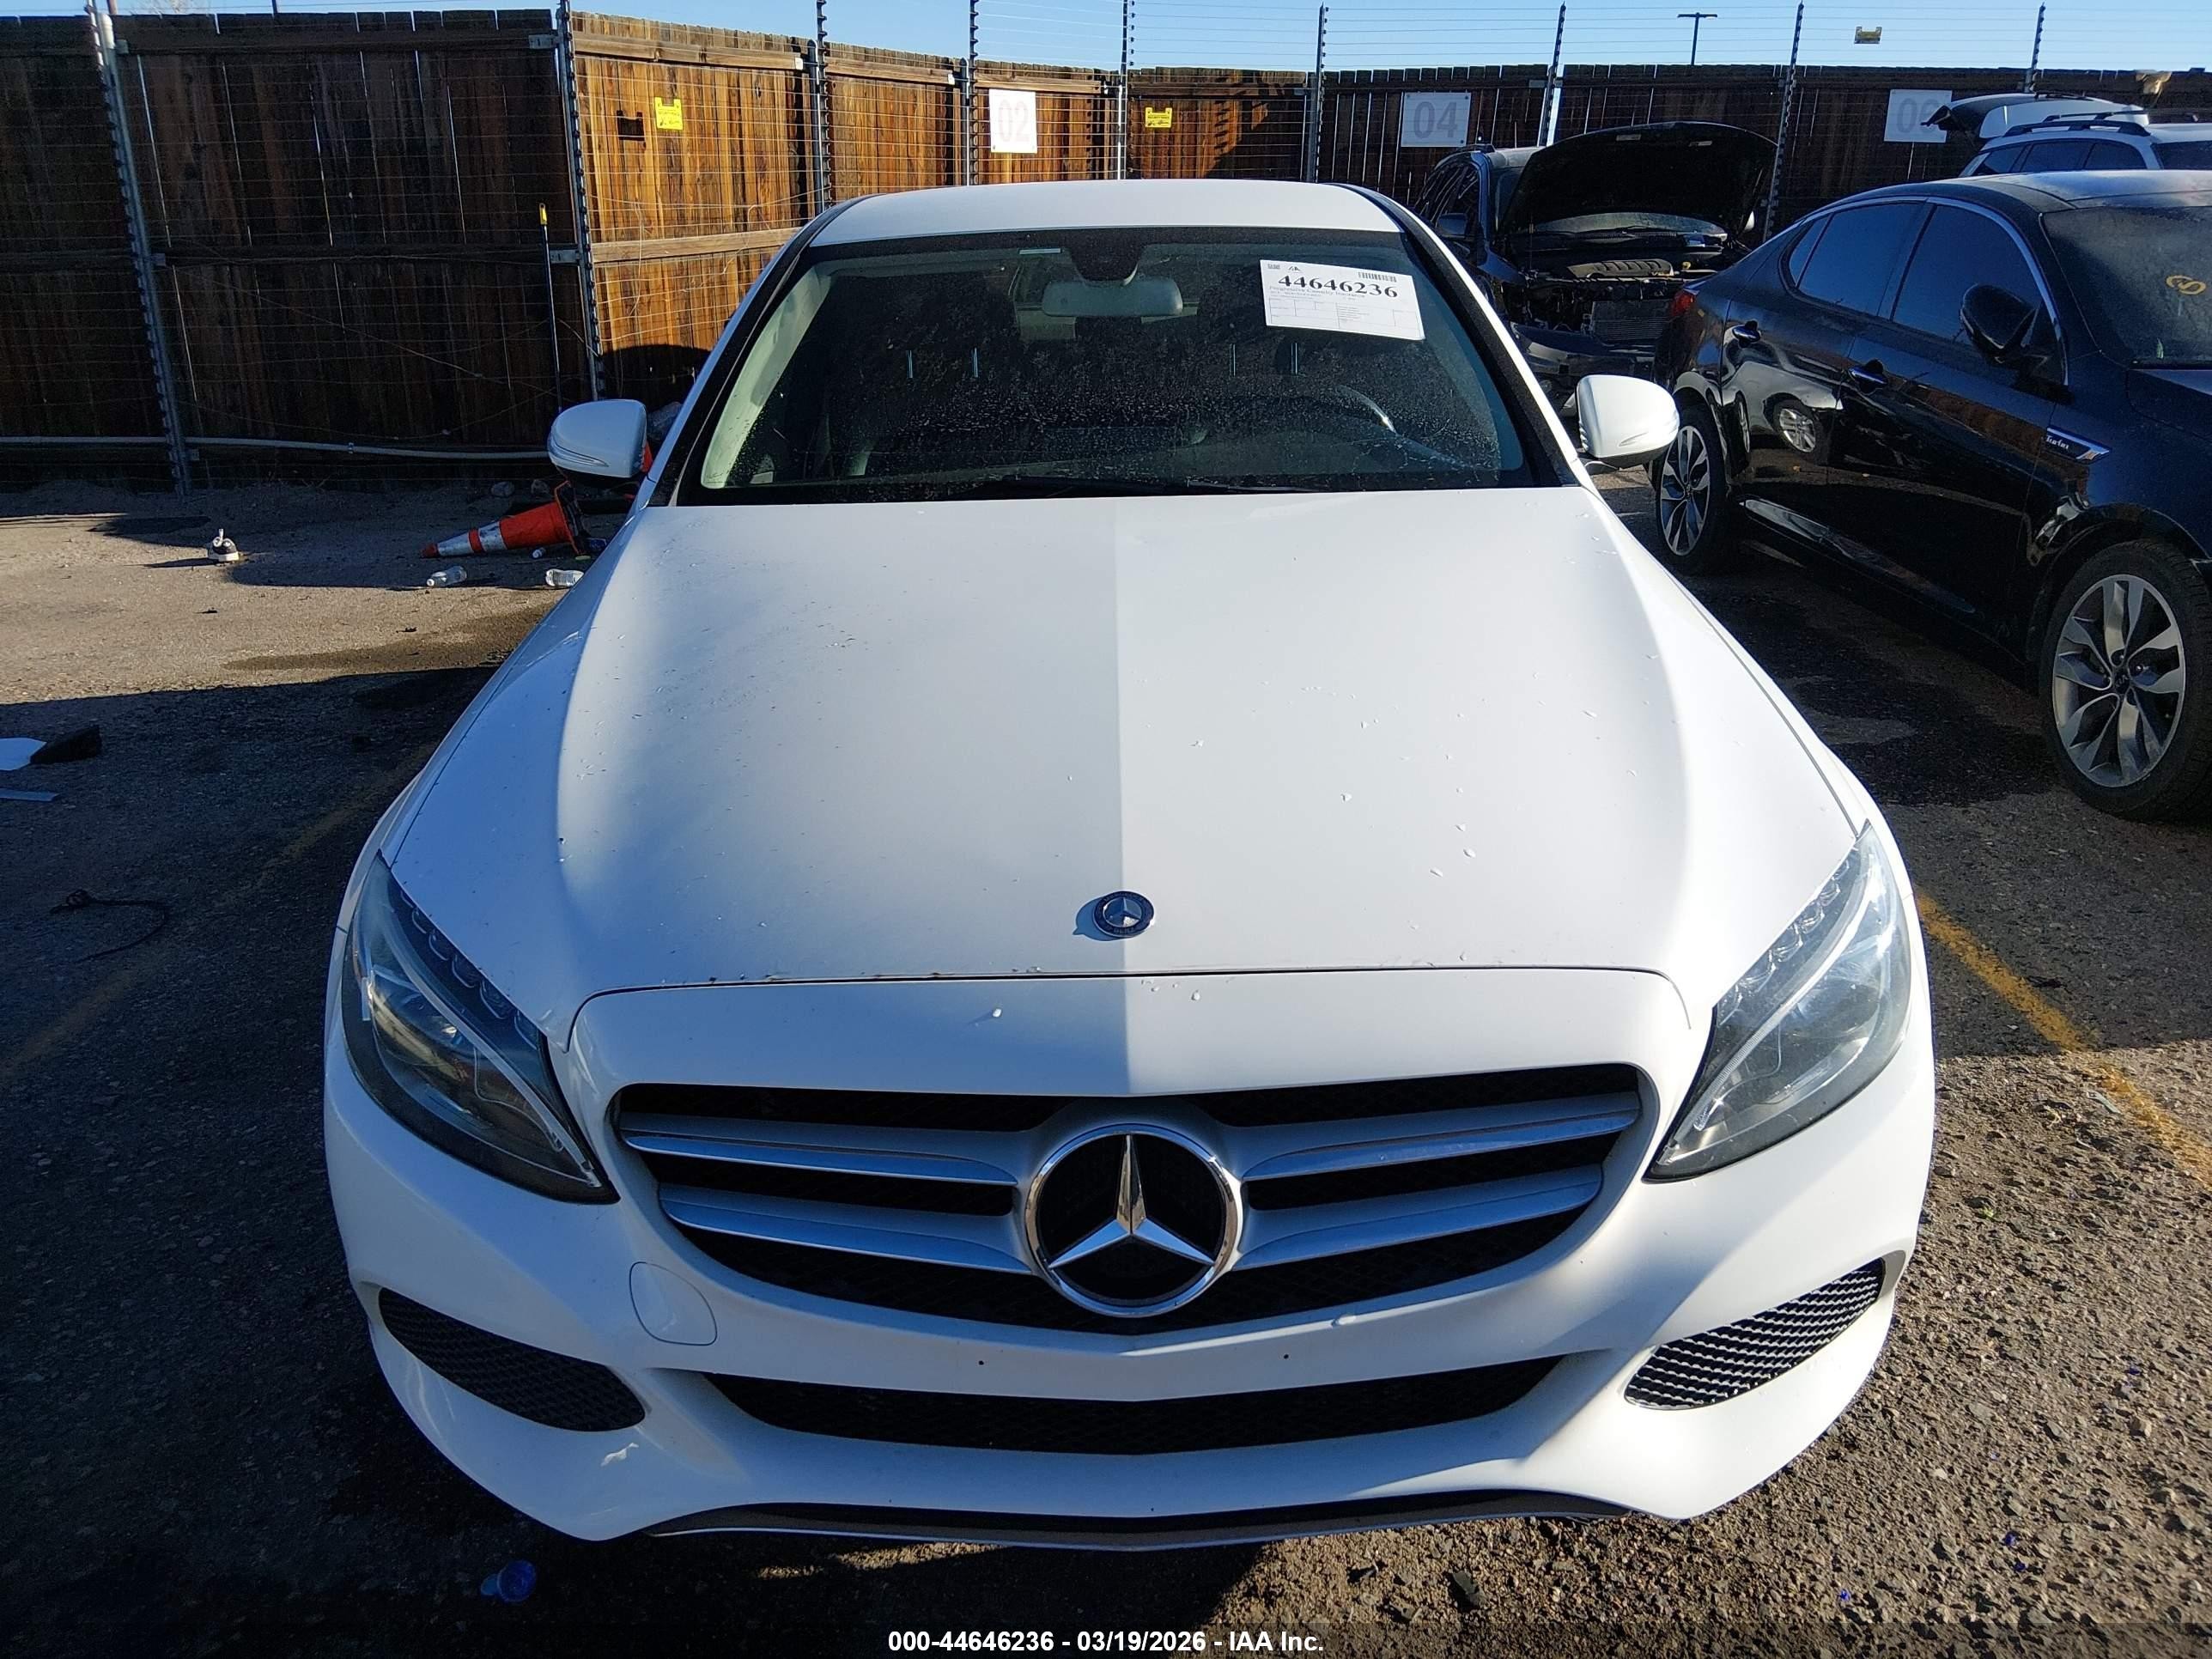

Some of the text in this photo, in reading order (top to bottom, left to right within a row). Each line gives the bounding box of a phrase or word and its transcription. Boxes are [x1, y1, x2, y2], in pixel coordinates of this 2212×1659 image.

[998, 99, 1030, 143] 02
[1413, 101, 1458, 138] 04
[1278, 275, 1398, 298] 44646236
